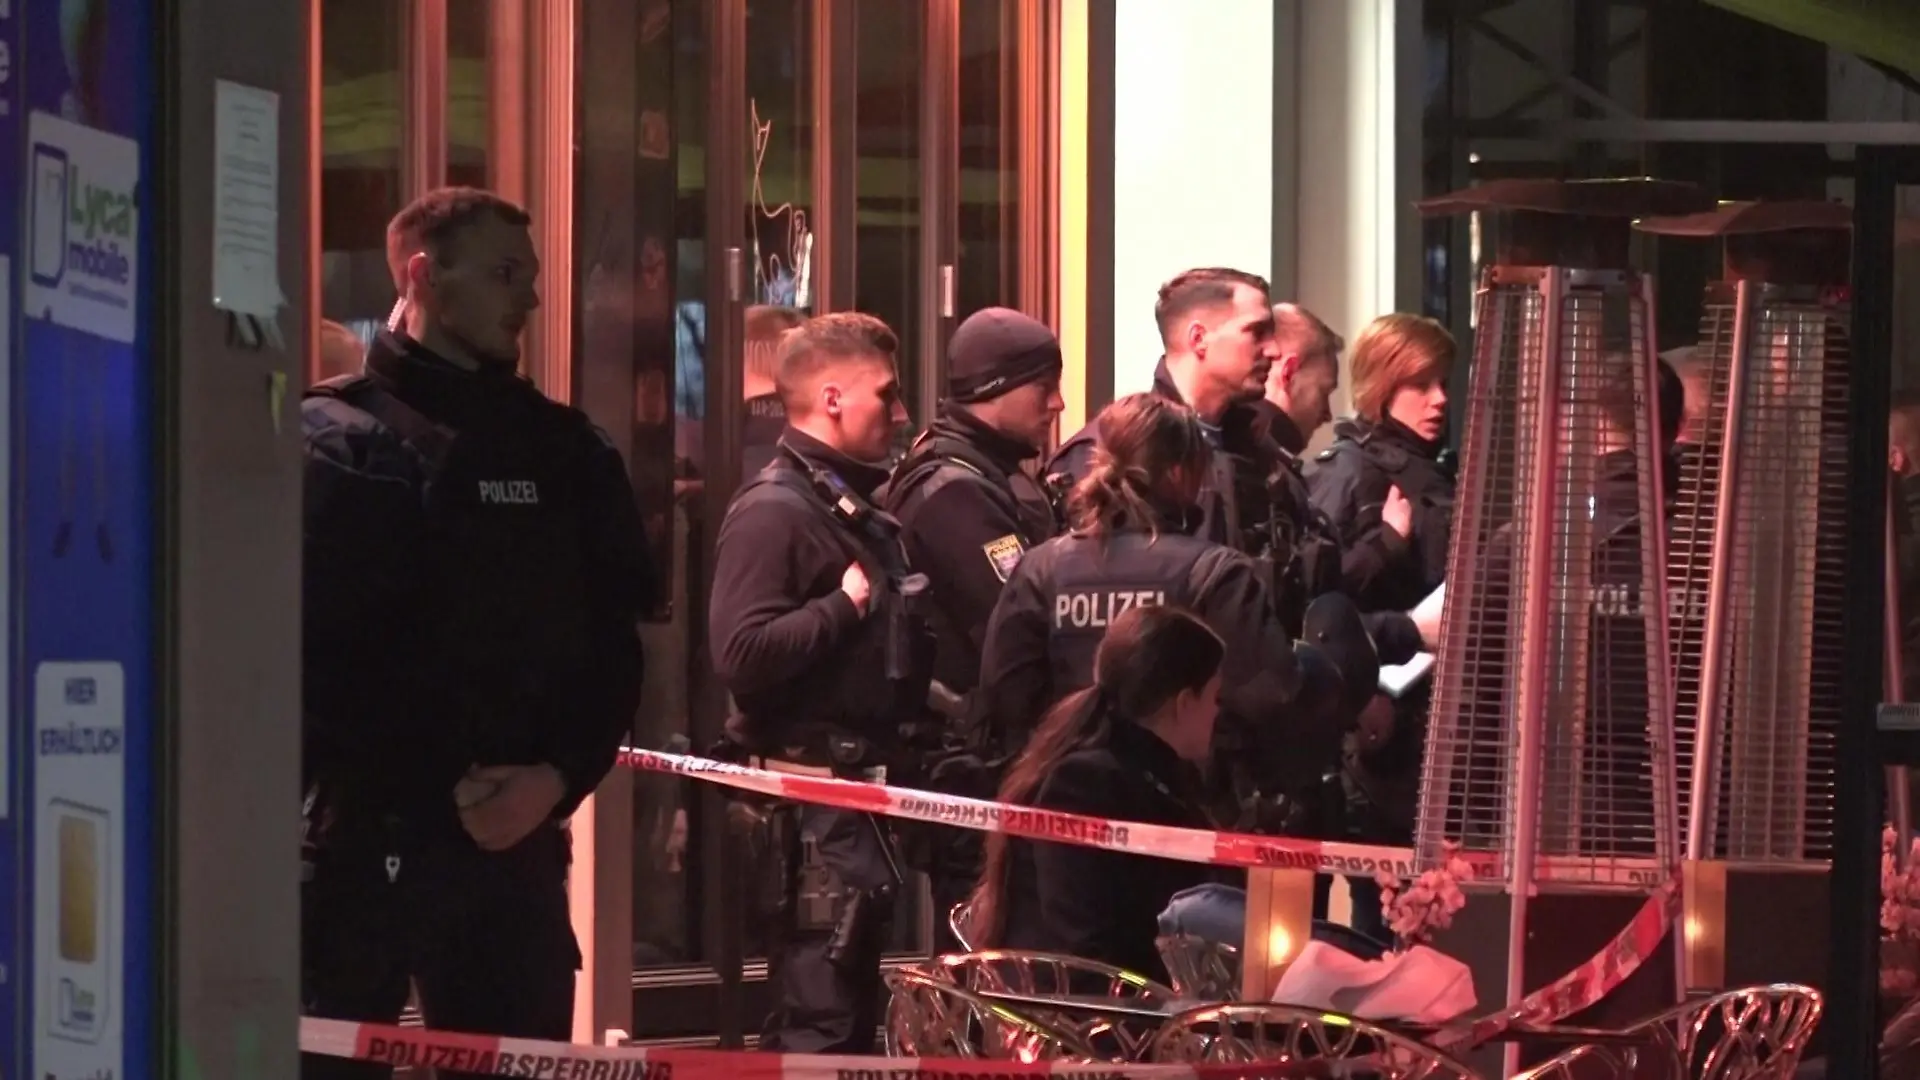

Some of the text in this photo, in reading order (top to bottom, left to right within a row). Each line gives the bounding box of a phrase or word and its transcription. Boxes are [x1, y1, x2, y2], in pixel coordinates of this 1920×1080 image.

[69, 164, 129, 240] Lyca
[69, 240, 129, 285] mobile
[478, 480, 539, 504] POLIZEI
[366, 1036, 674, 1080] POLIZEIABSPERRUNG
